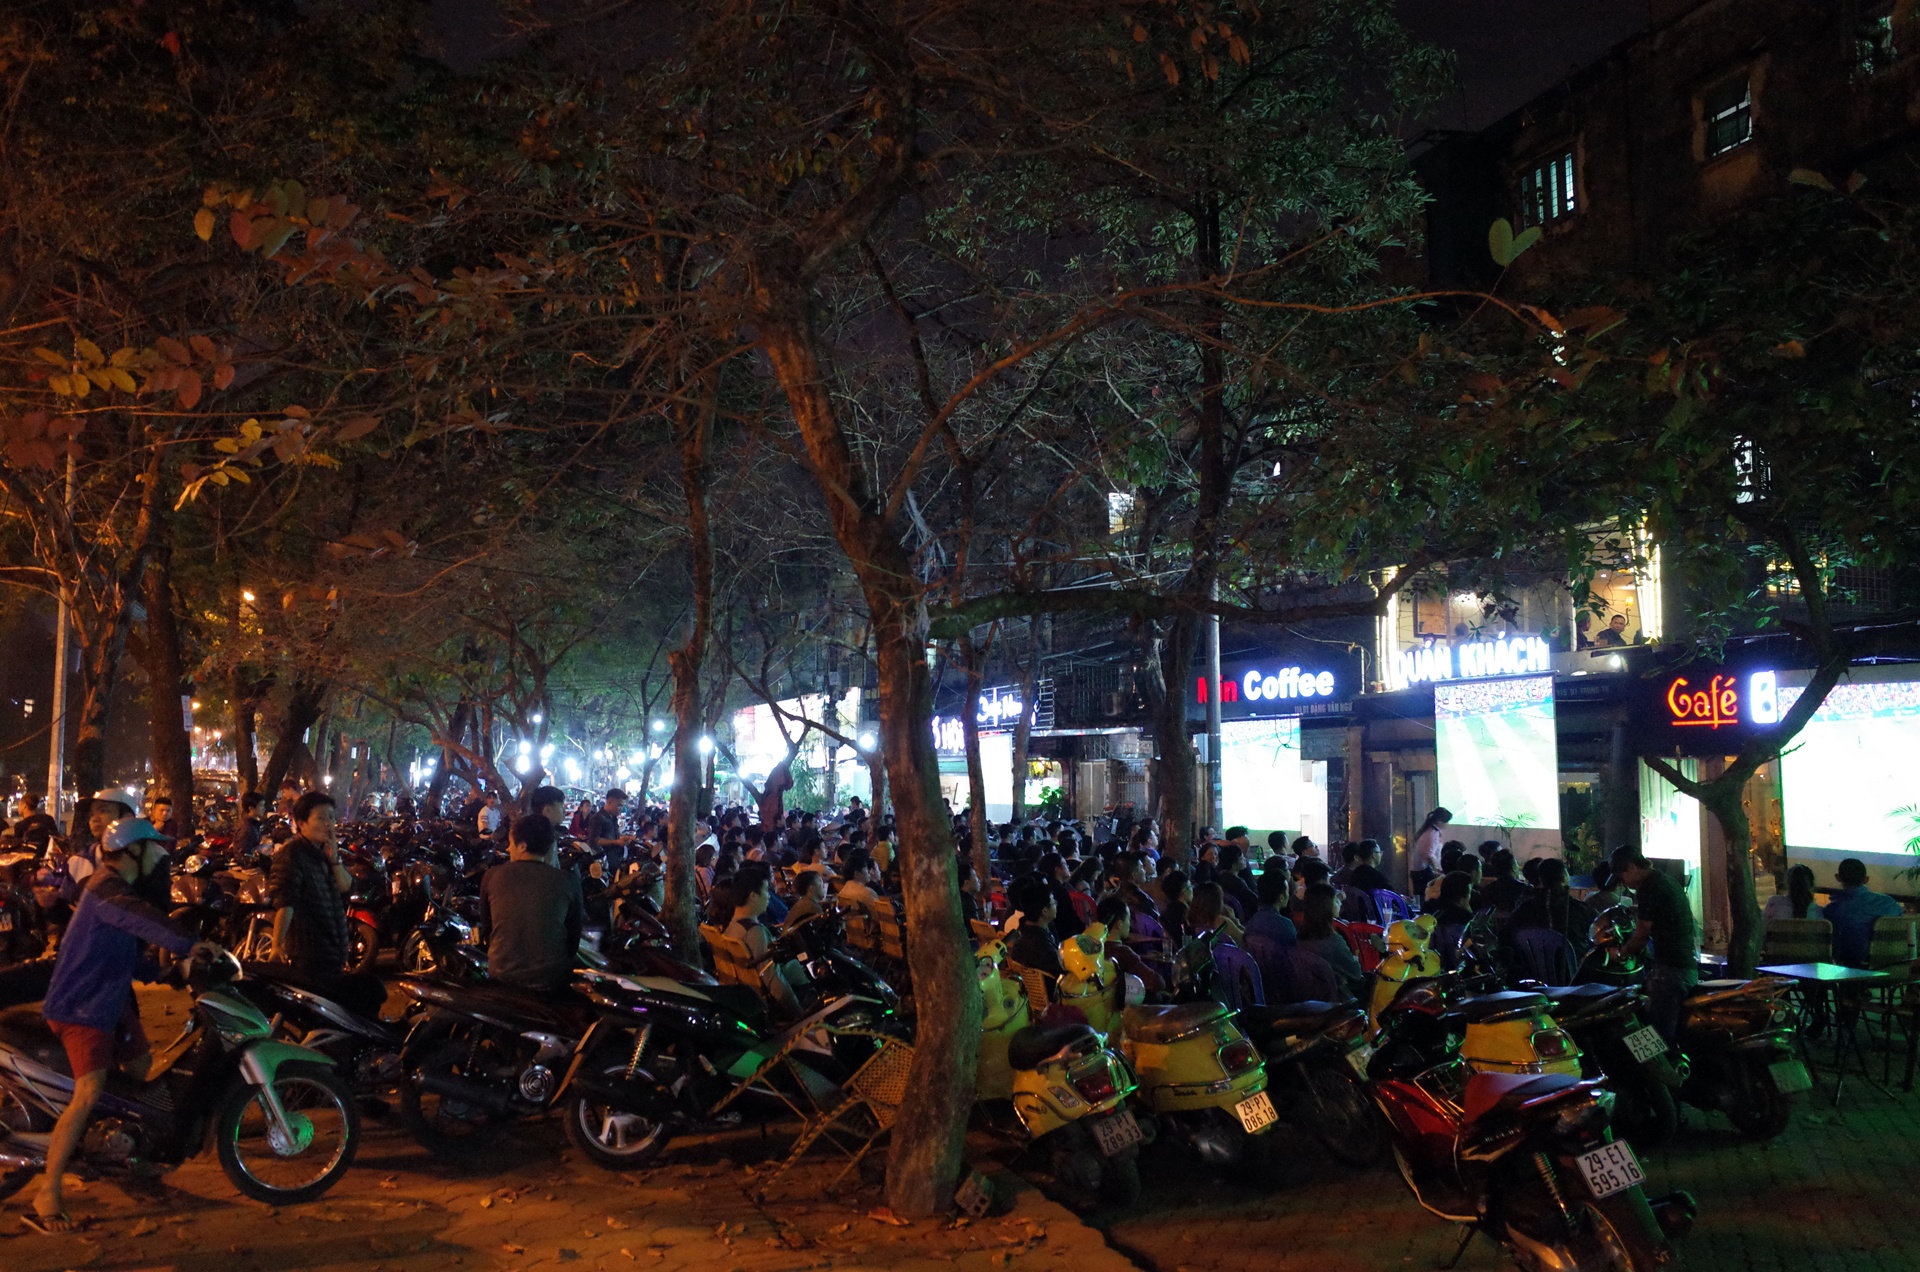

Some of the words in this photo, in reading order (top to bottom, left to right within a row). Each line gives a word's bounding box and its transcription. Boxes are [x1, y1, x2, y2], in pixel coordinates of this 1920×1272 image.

[1459, 631, 1550, 678] KHÁCH
[1243, 666, 1335, 701] Coffee
[1240, 1094, 1267, 1116] 29-P1
[1244, 1106, 1276, 1131] 086.18
[1584, 1144, 1626, 1174] 29-E1
[1590, 1162, 1640, 1194] 595.16
